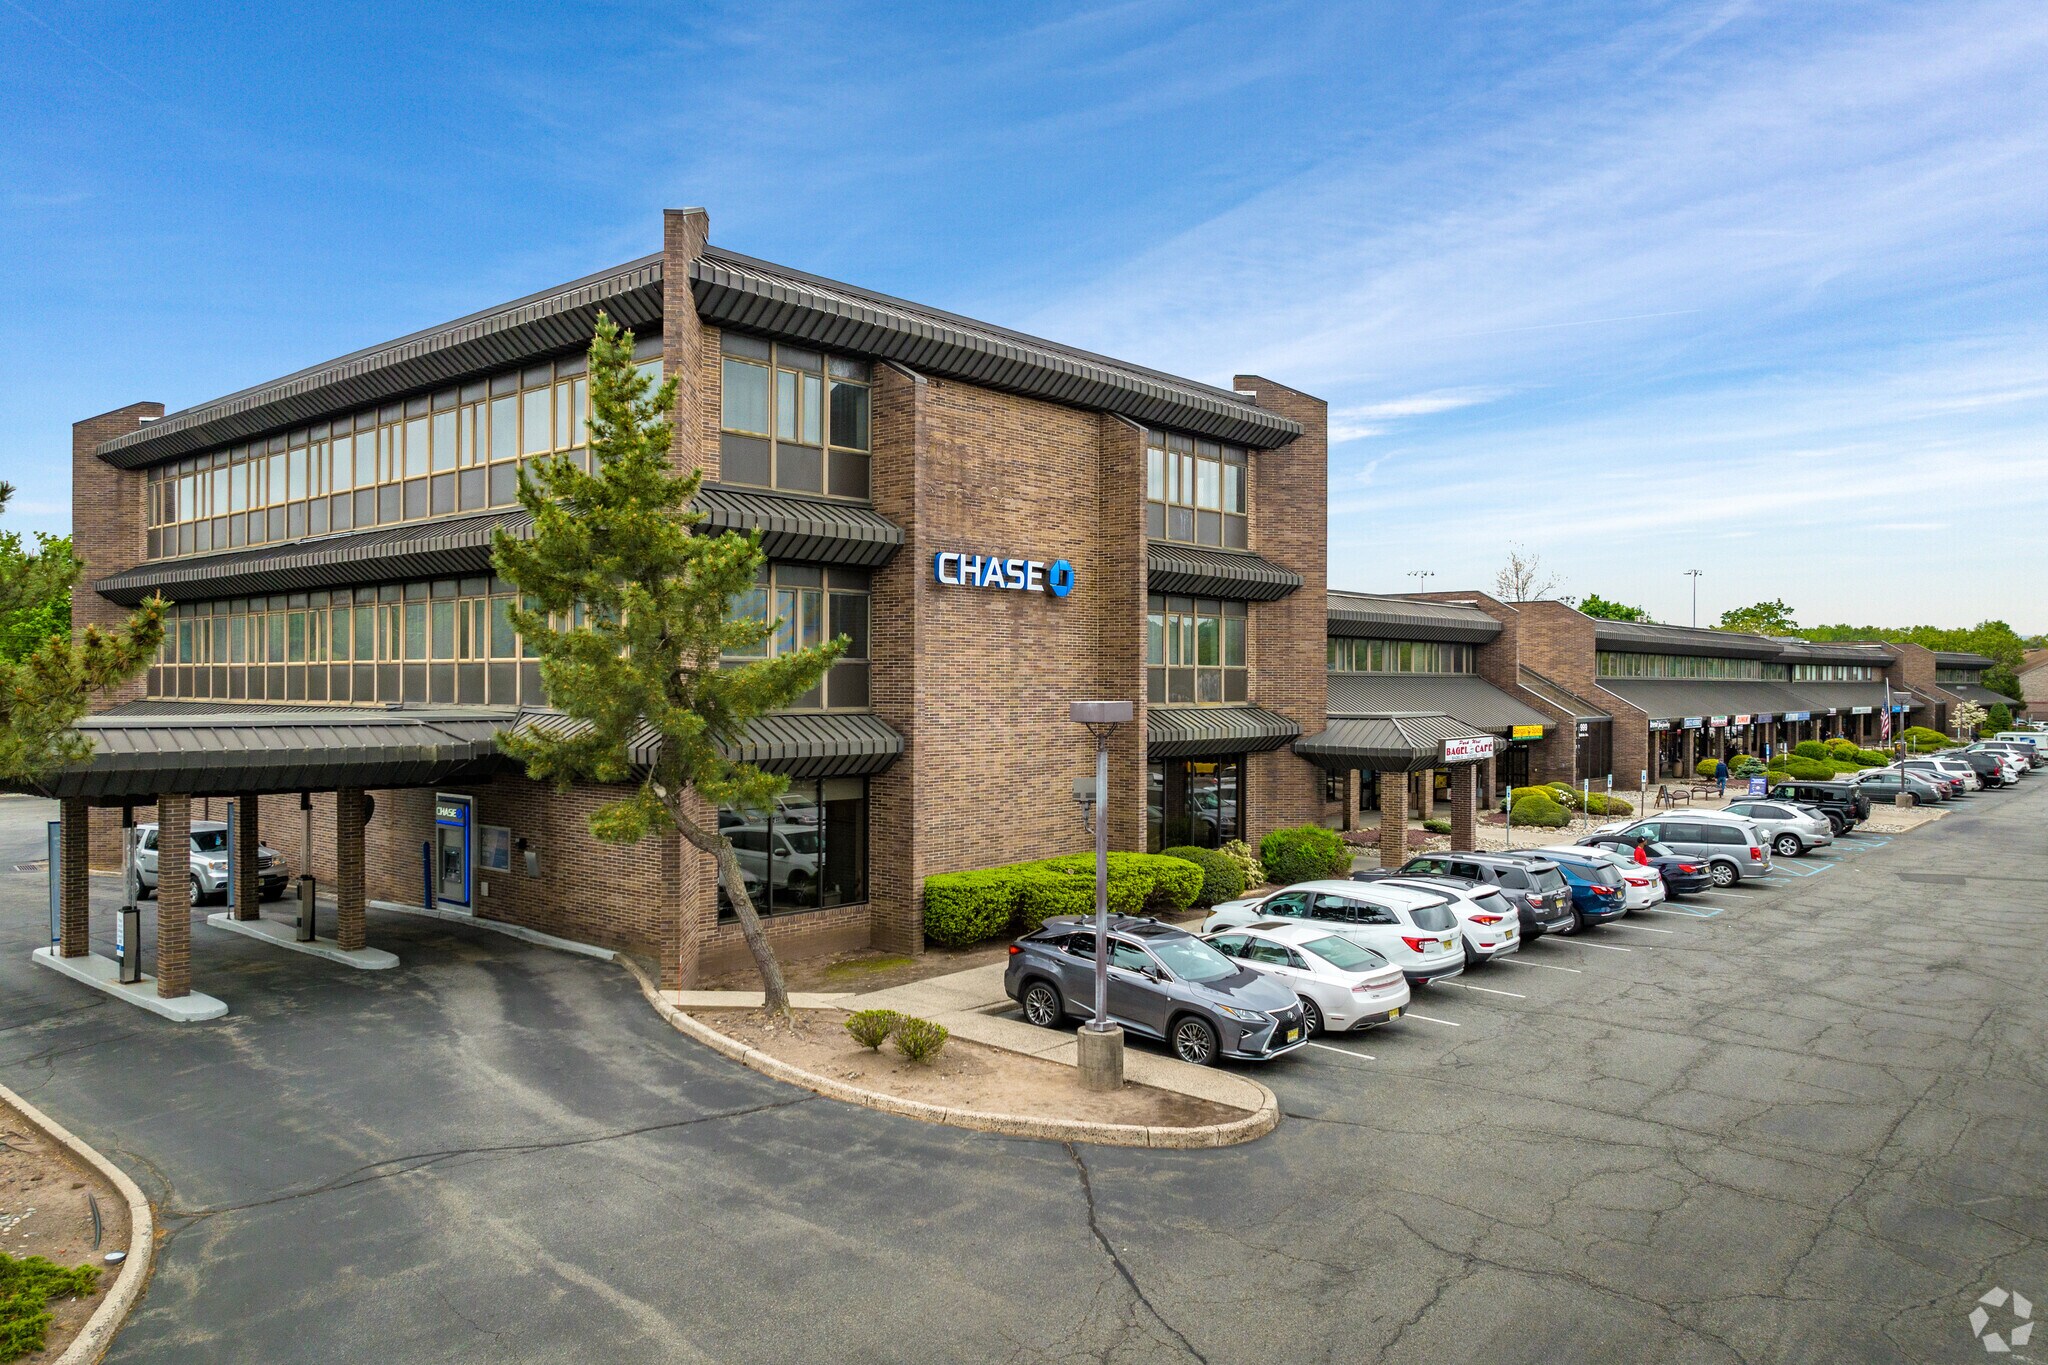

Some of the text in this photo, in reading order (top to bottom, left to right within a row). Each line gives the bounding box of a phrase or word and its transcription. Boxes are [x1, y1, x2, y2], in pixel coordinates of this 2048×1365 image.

[934, 551, 1044, 592] CHASE
[1446, 746, 1469, 756] BAGEL
[436, 807, 457, 818] CHASE
